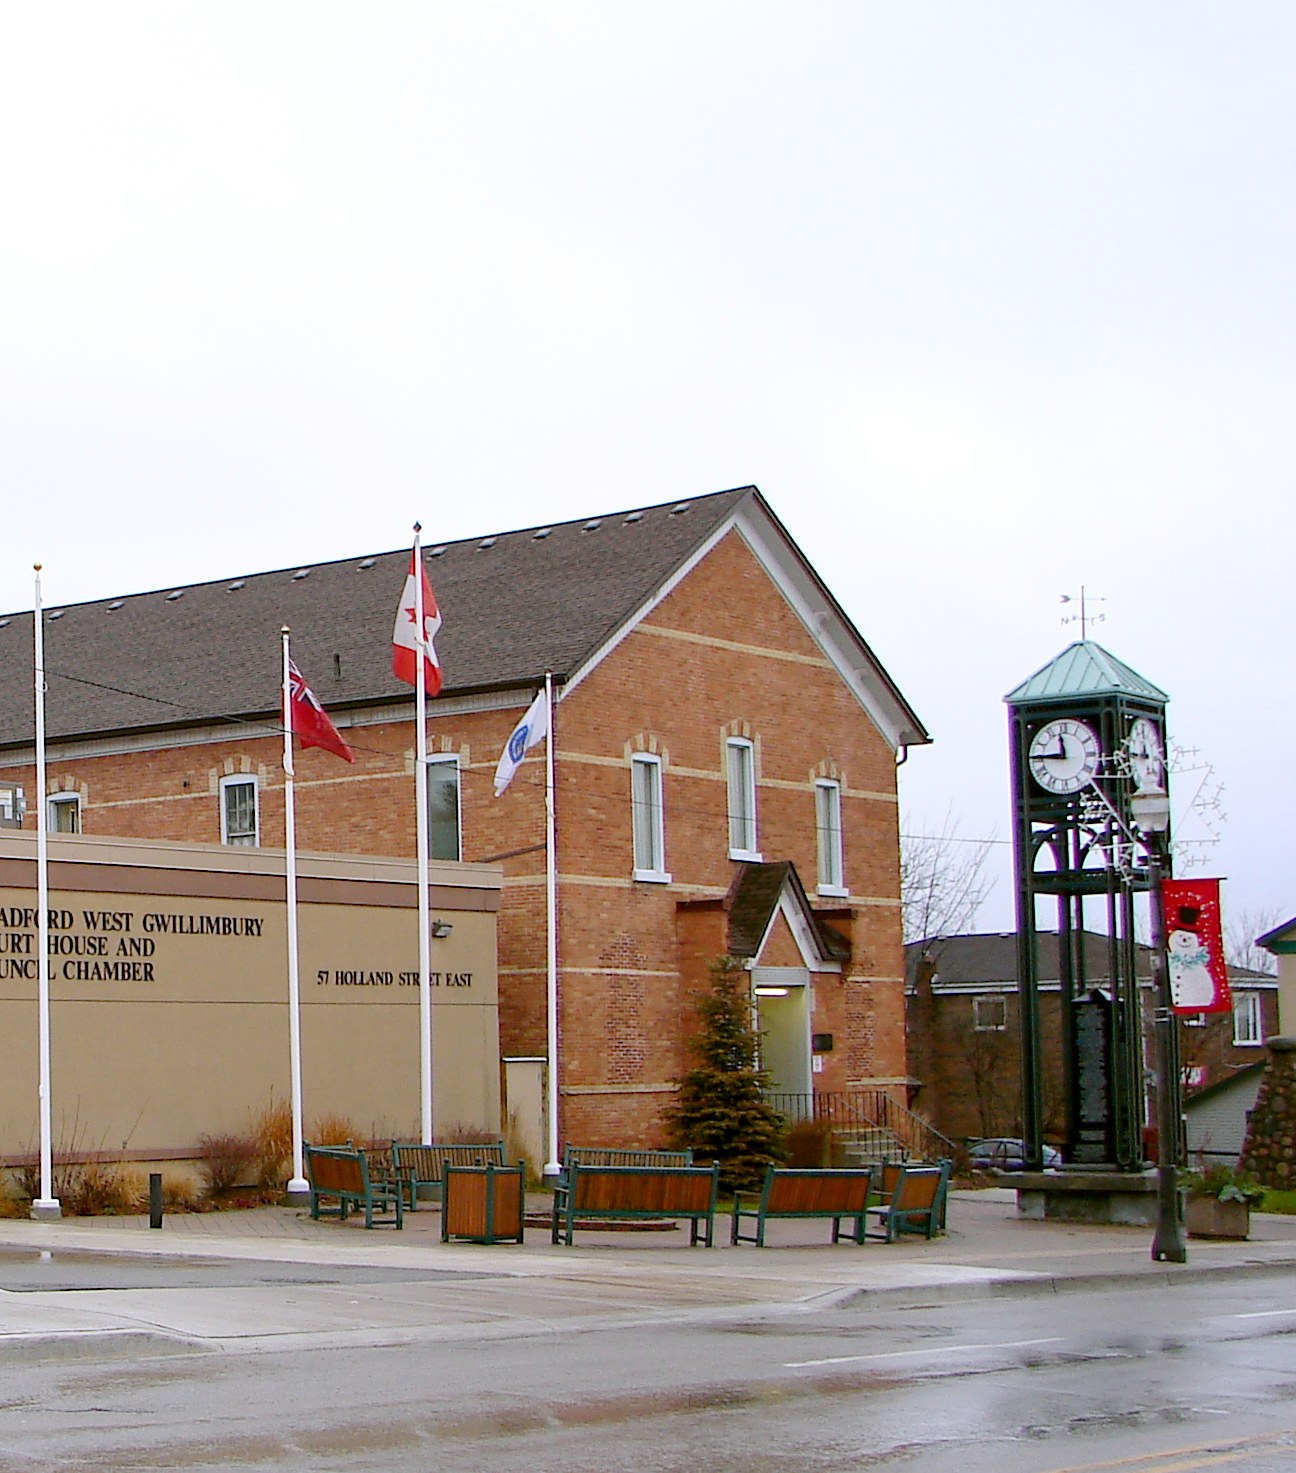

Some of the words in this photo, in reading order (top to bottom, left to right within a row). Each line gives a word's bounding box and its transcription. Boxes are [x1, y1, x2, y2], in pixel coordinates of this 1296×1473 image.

[83, 911, 134, 932] WEST
[142, 913, 264, 937] GWILLIMBURY
[47, 934, 109, 956] HOUSE
[116, 937, 156, 957] AND
[63, 960, 155, 982] CHAMBER
[317, 970, 329, 986] 57
[335, 970, 393, 986] HOLLAND
[399, 971, 442, 987] STRET
[446, 973, 473, 987] EAST
